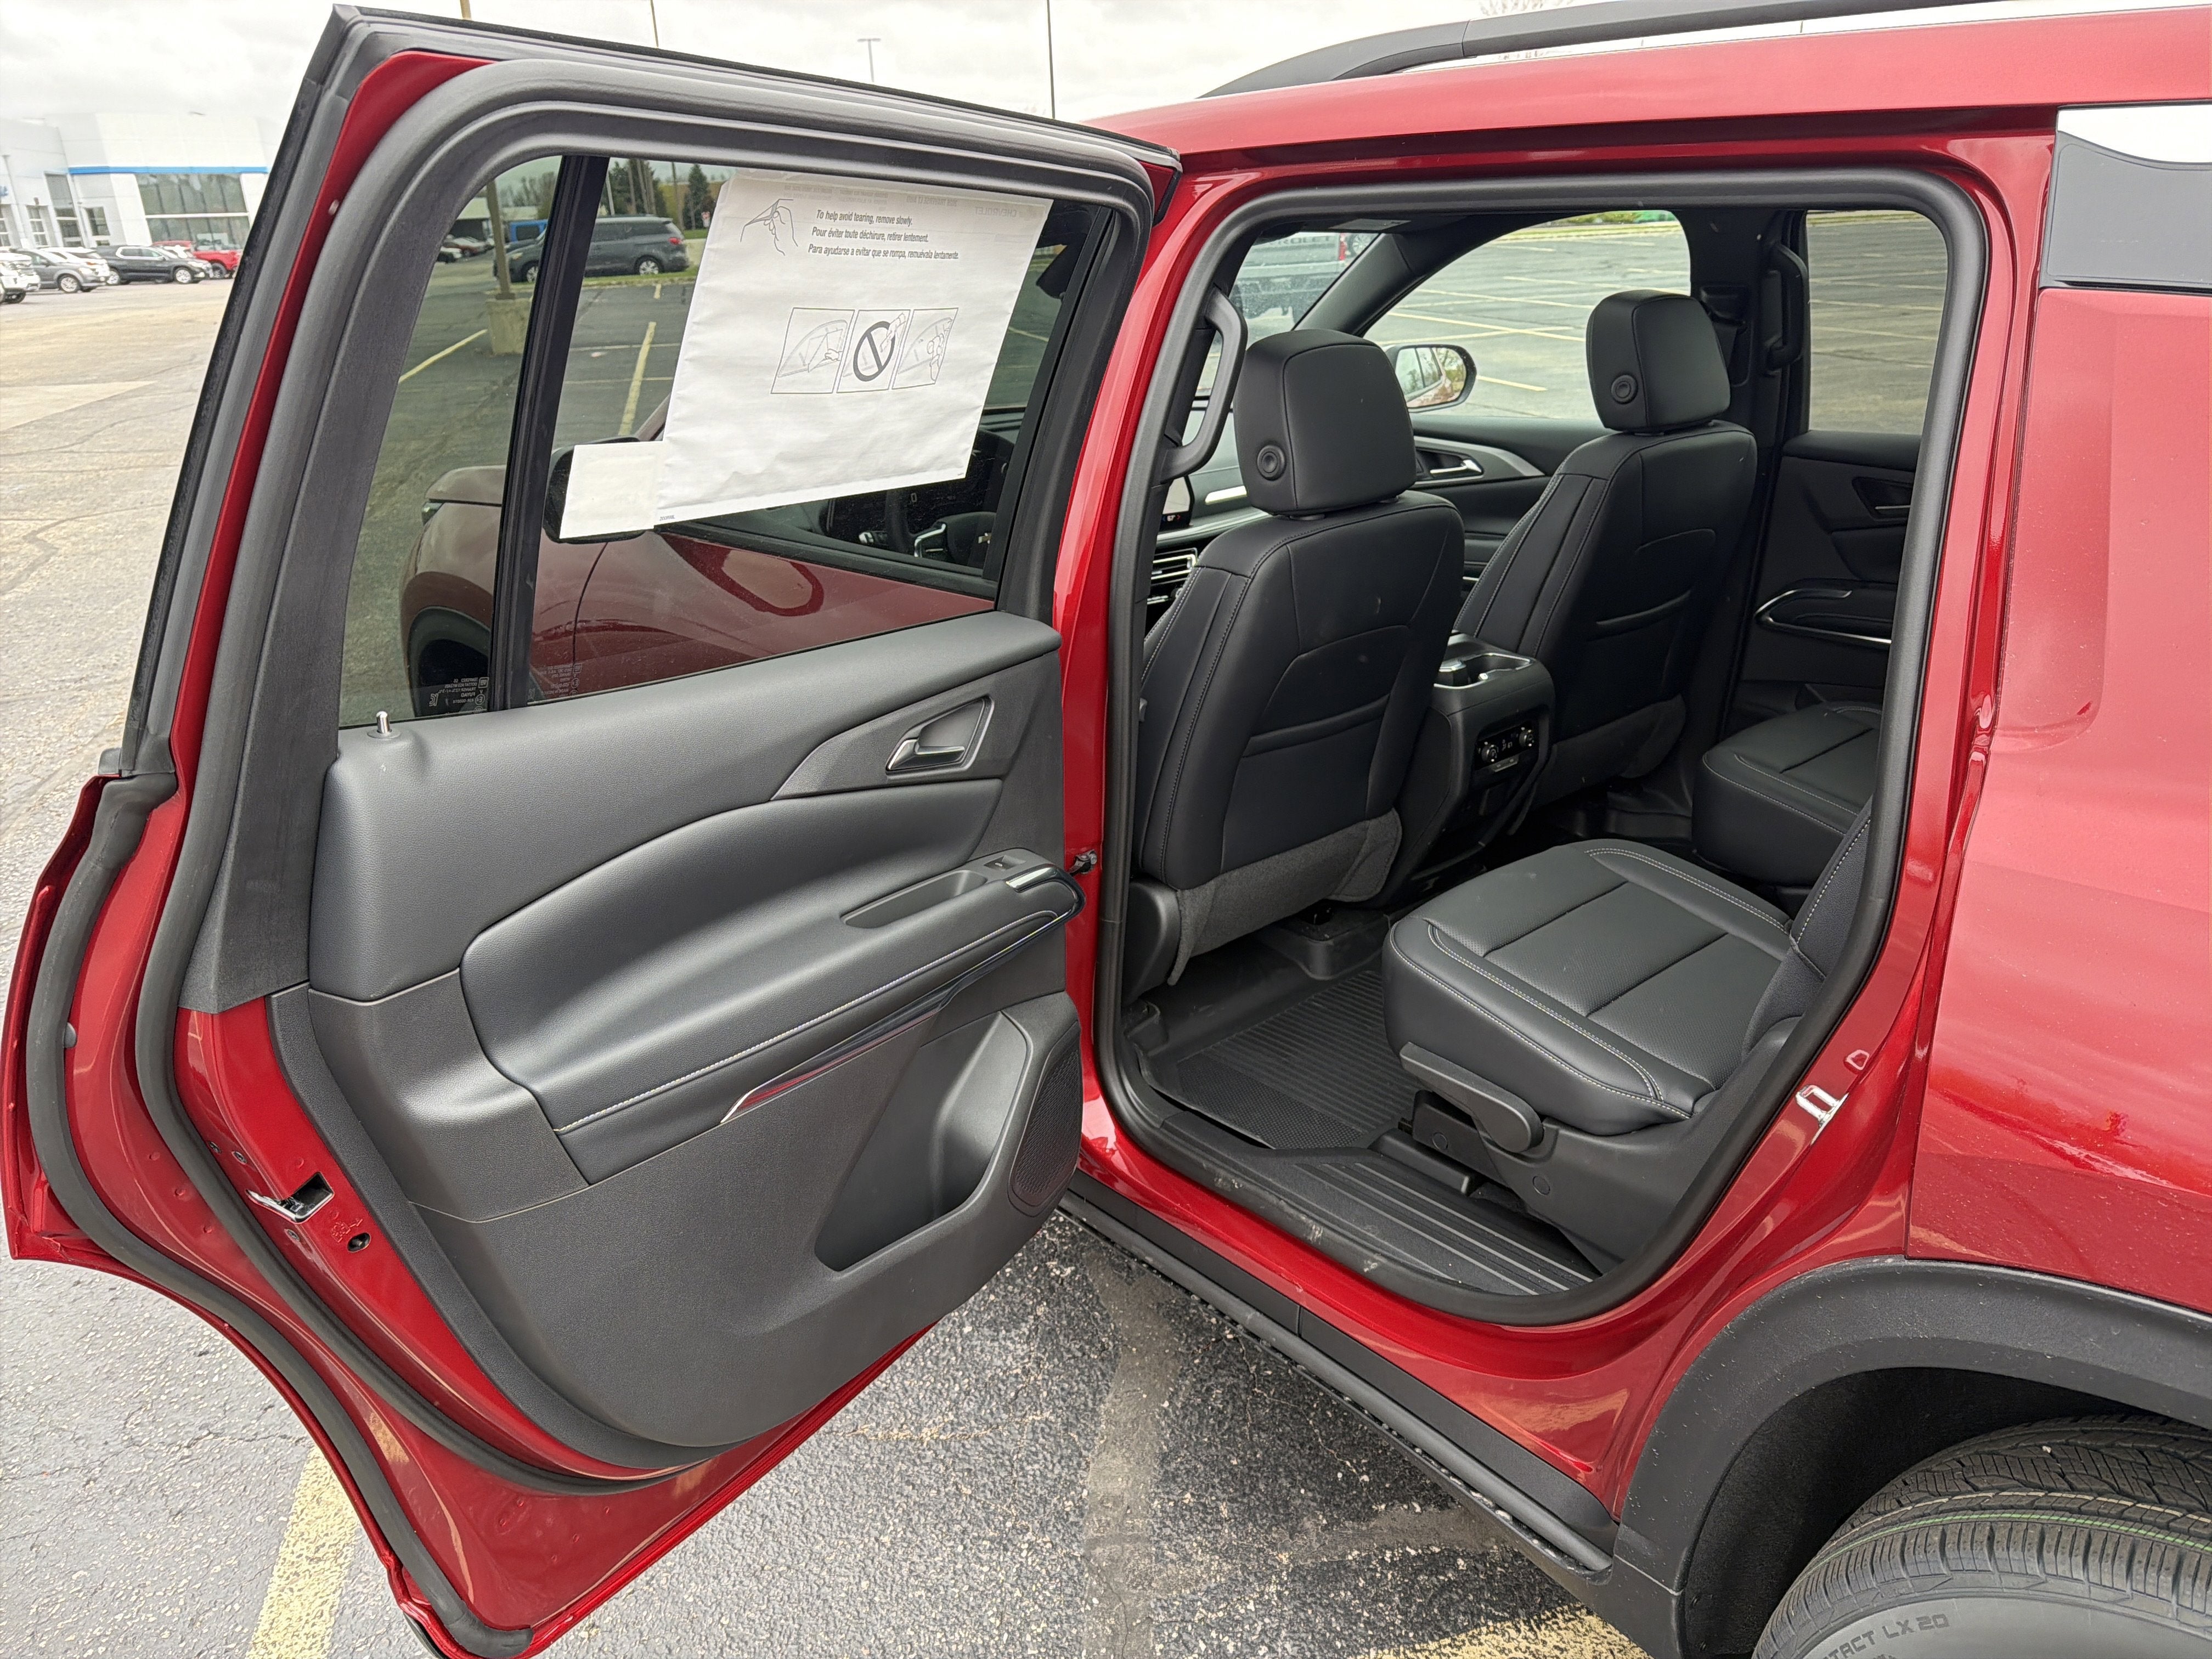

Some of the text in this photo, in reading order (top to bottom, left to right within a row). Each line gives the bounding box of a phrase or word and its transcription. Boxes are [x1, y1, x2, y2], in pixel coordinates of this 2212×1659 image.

[816, 209, 912, 227] To help avoid tearing, remove slowly.
[812, 226, 827, 236] Pour
[828, 227, 844, 238] éviter
[844, 229, 858, 238] toute
[859, 229, 885, 241] déchirure,
[887, 232, 903, 241] retirer
[808, 243, 822, 254] Para
[823, 246, 849, 256] ayudarse
[855, 247, 871, 256] evitar
[871, 250, 882, 258] que
[889, 250, 906, 259] rompa,
[1882, 1613, 1950, 1639] LX 20
[1823, 1630, 1875, 1659] TACT
